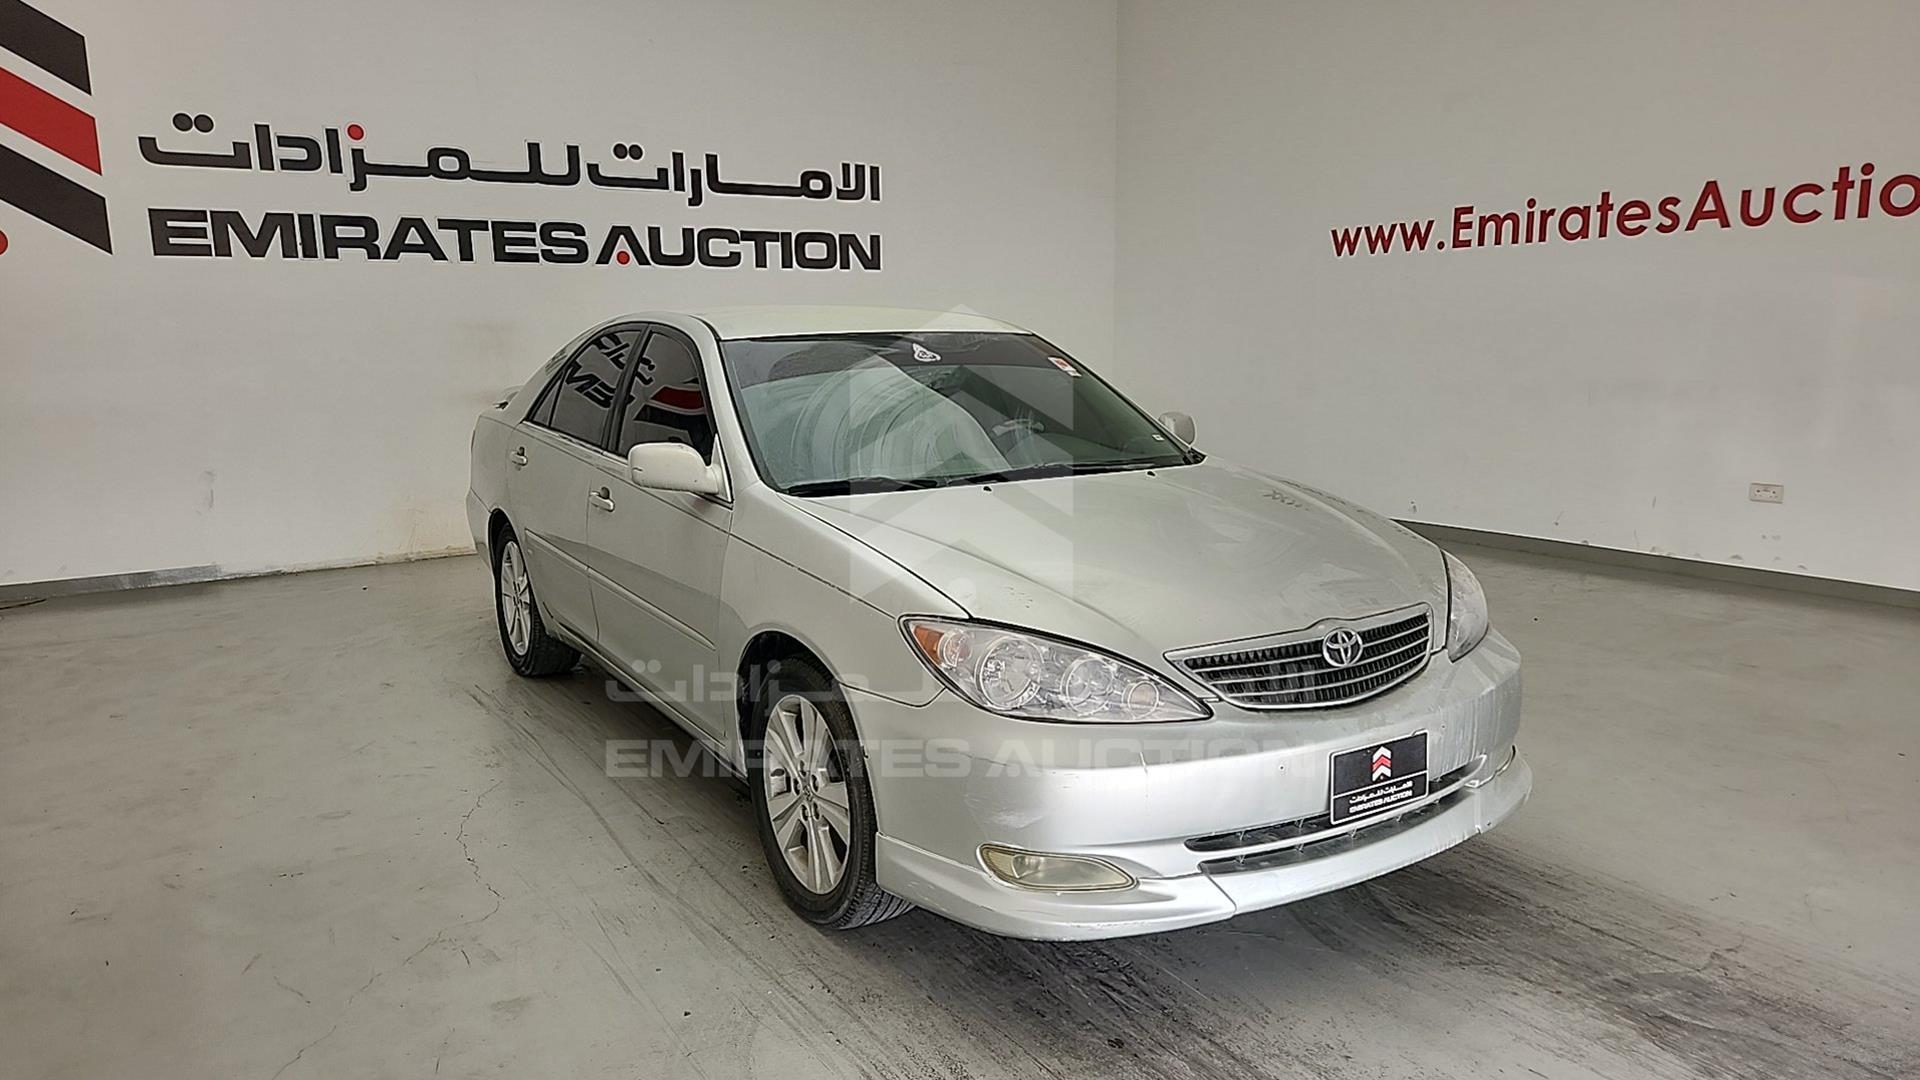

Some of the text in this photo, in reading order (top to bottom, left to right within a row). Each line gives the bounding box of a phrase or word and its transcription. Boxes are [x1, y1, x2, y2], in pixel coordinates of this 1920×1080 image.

[138, 112, 881, 207] الامارات للمزادات
[148, 207, 881, 271] EMIRATES AUCTION
